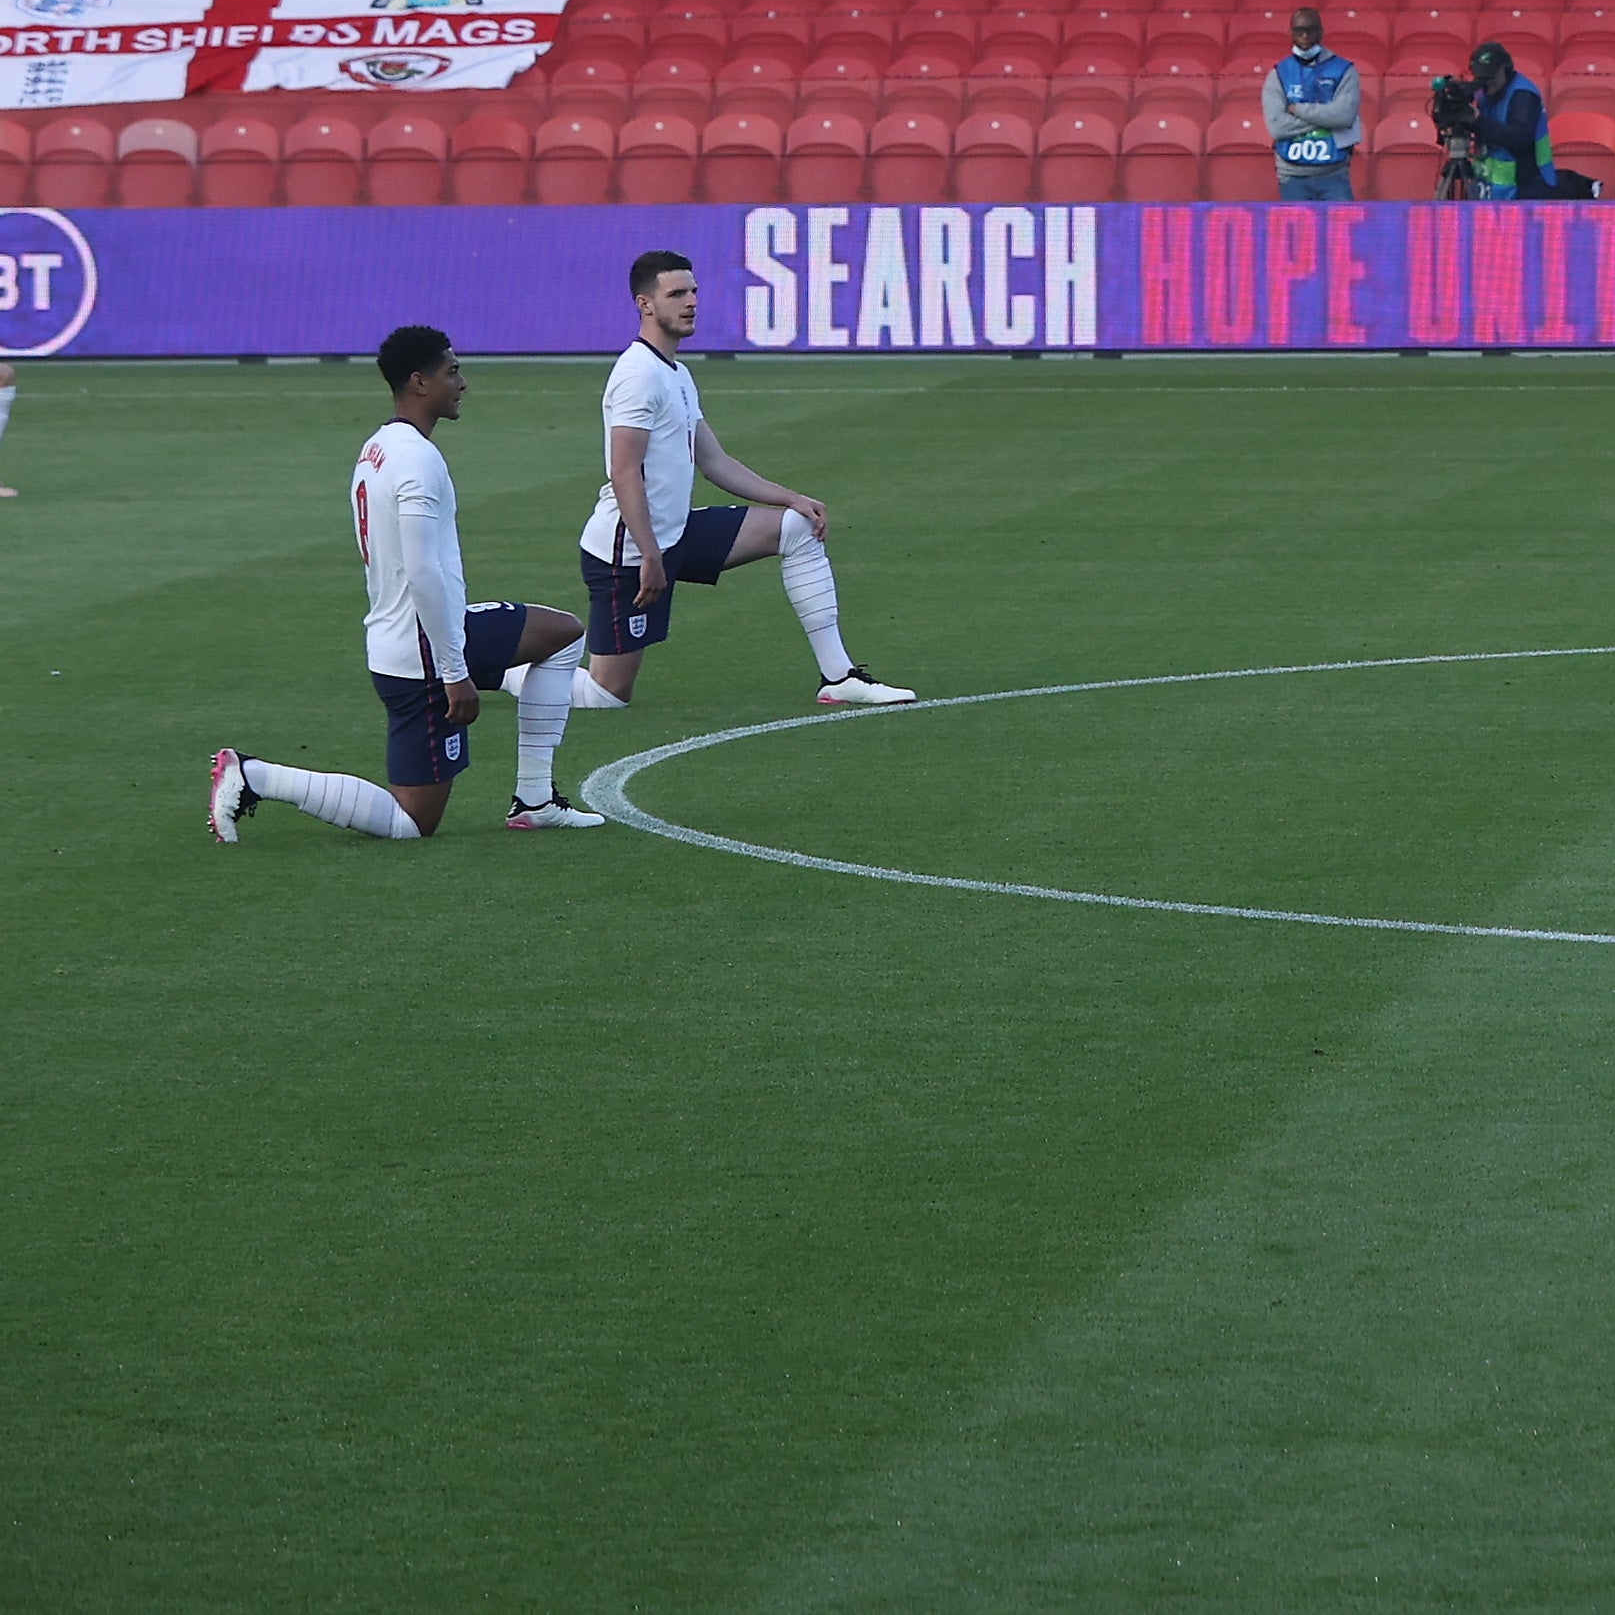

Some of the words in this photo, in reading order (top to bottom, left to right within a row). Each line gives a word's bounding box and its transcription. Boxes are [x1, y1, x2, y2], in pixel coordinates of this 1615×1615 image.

[371, 17, 537, 46] MAGS
[1287, 139, 1332, 161] 002
[744, 205, 1097, 348] SEARCH
[1140, 205, 1367, 345] HOPE
